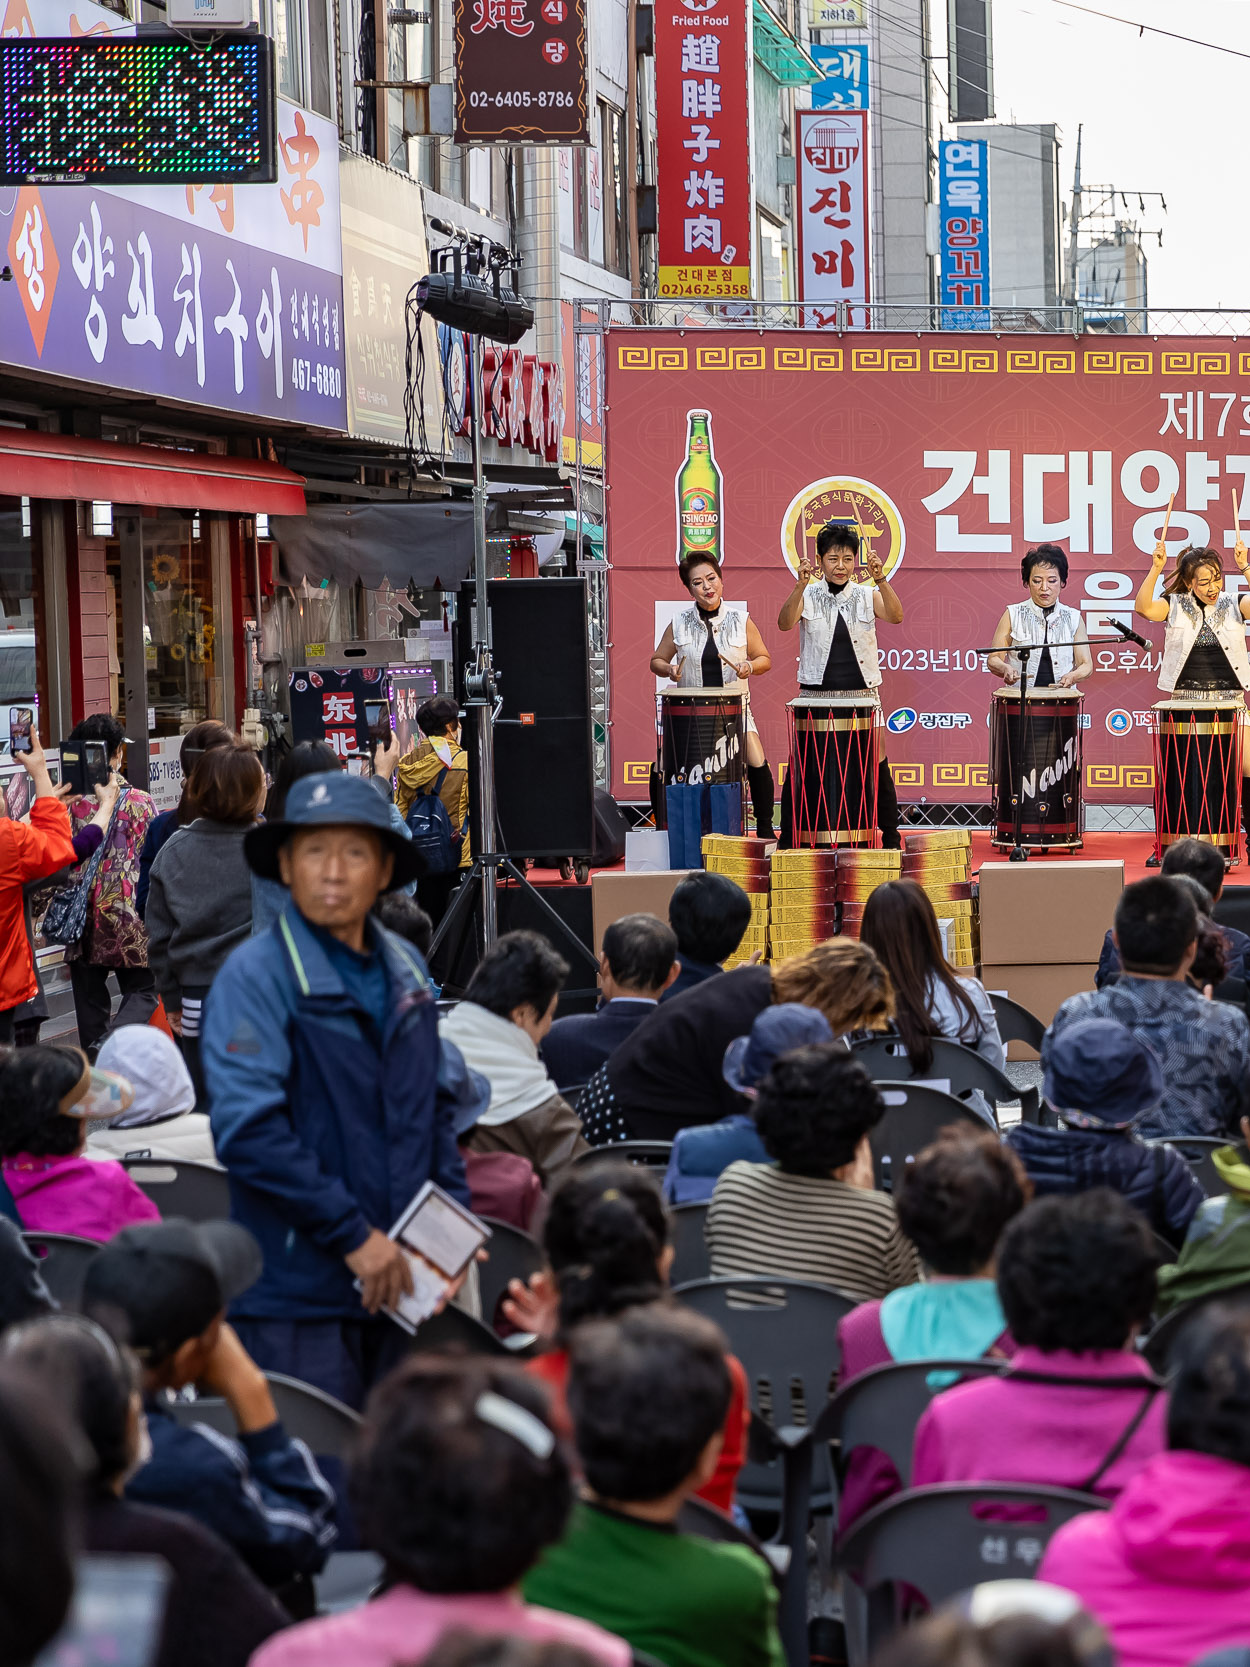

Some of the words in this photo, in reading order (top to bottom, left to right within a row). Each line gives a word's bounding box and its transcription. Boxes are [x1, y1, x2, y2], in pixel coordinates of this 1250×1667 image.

[672, 15, 700, 26] Fried
[702, 15, 729, 26] Food
[469, 91, 574, 107] 02-6405-8786
[681, 34, 724, 254] 趙胖子炸肉
[811, 148, 854, 169] 진미
[677, 269, 732, 282] 건대본점
[662, 284, 748, 297] 02)462-5358
[71, 200, 284, 399] 양꼬치구이
[291, 357, 342, 399] 467-6880
[682, 513, 718, 523] TSINGTAO
[920, 713, 971, 728] 광진구
